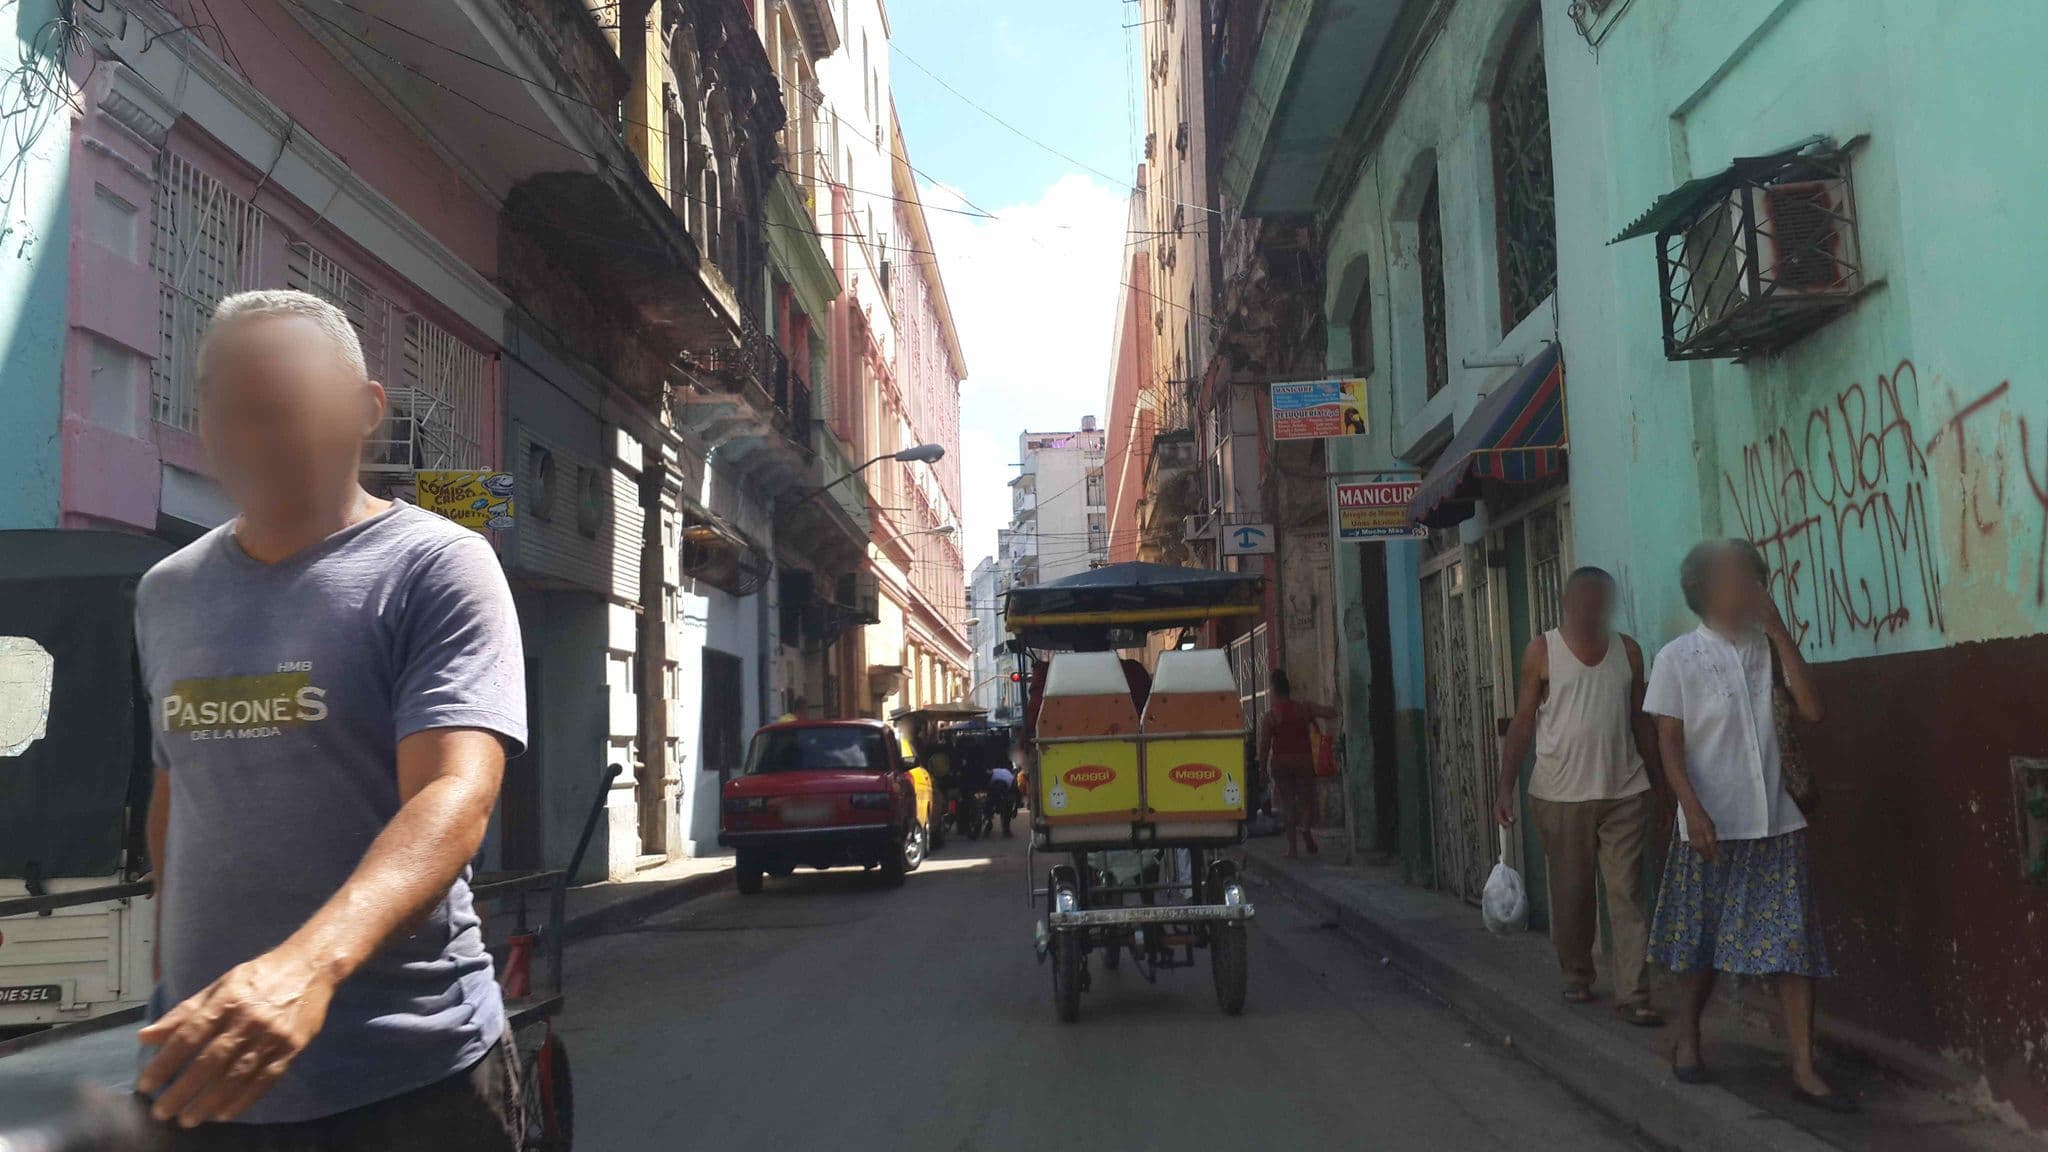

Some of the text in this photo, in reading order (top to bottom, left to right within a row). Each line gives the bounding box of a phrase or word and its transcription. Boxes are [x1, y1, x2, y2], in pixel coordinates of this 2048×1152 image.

[1340, 487, 1420, 505] MANICUR
[277, 660, 313, 672] HMB
[190, 726, 282, 741] DE LA MODA
[1069, 770, 1110, 783] Maggi
[1175, 768, 1216, 781] Maggi
